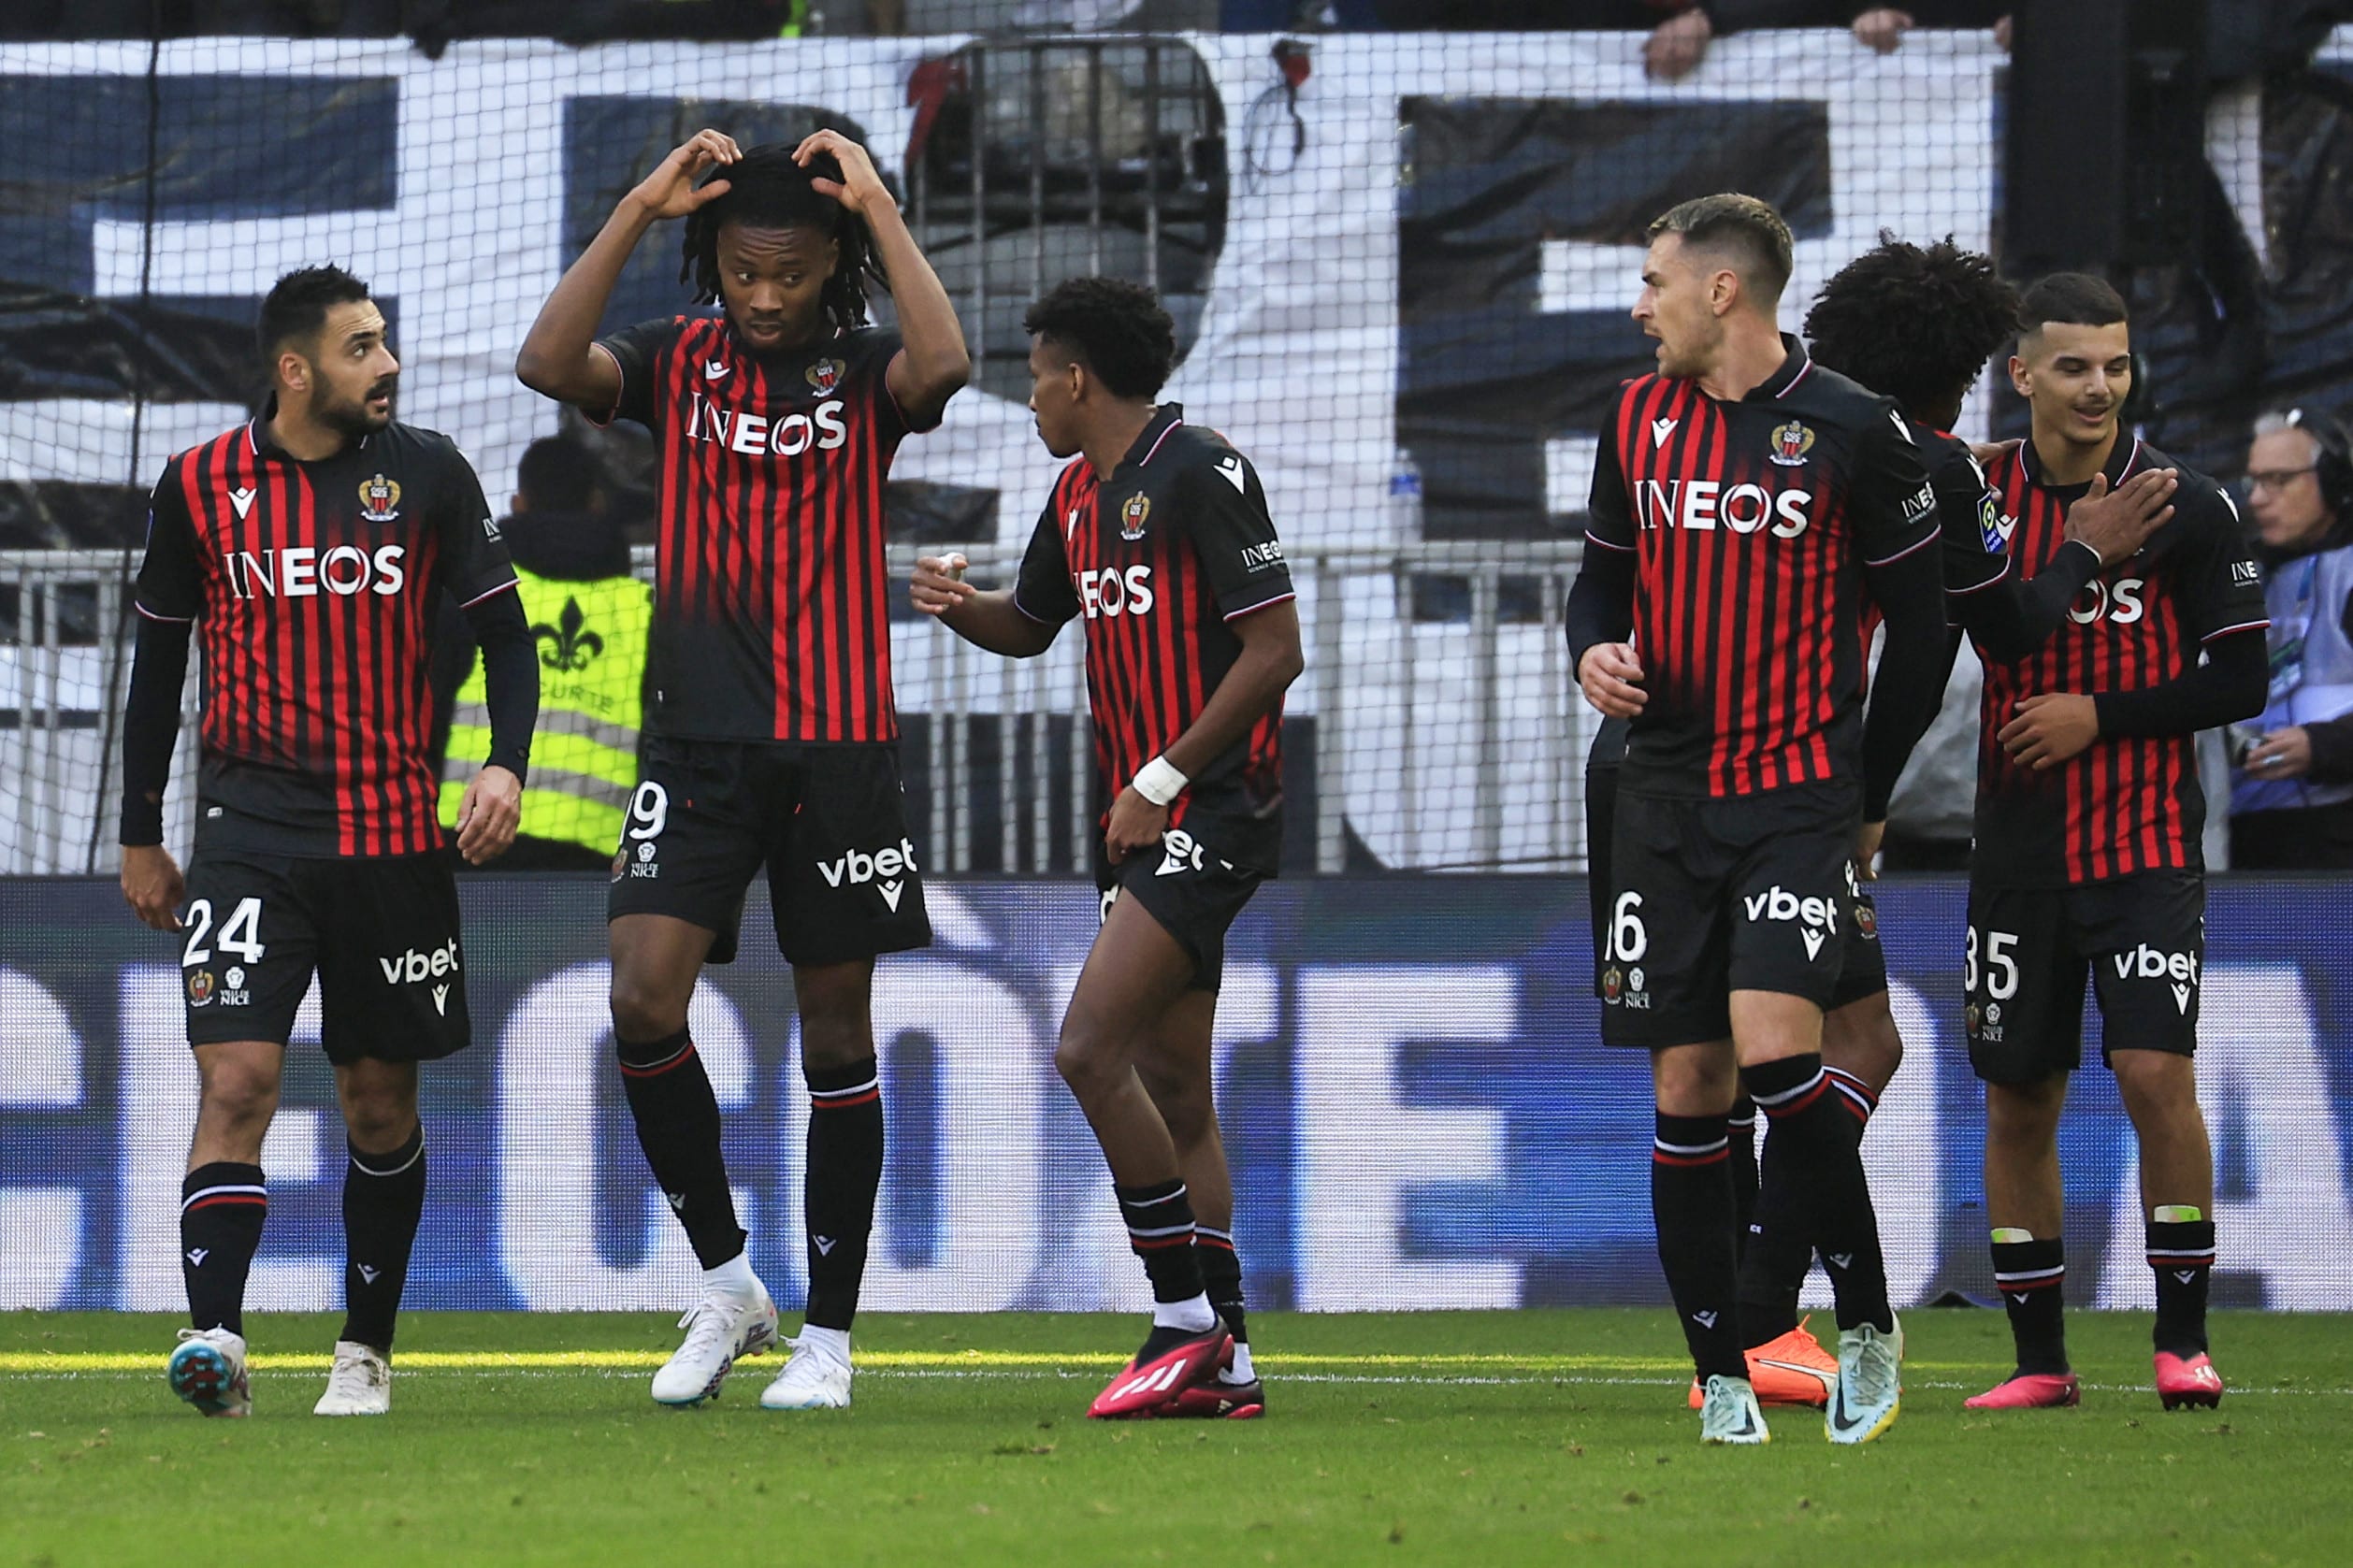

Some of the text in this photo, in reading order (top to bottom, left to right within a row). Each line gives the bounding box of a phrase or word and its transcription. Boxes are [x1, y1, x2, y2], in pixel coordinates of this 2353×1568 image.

[686, 392, 846, 456] INEOS
[1634, 479, 1812, 539] INEOS
[224, 544, 406, 599] INEOS
[619, 780, 669, 845] 9
[816, 837, 917, 888] vbet
[182, 897, 266, 968] 24
[1743, 885, 1838, 936] vbet
[379, 937, 458, 985] vbet
[2115, 942, 2198, 986] vbet
[220, 996, 250, 1006] NICE
